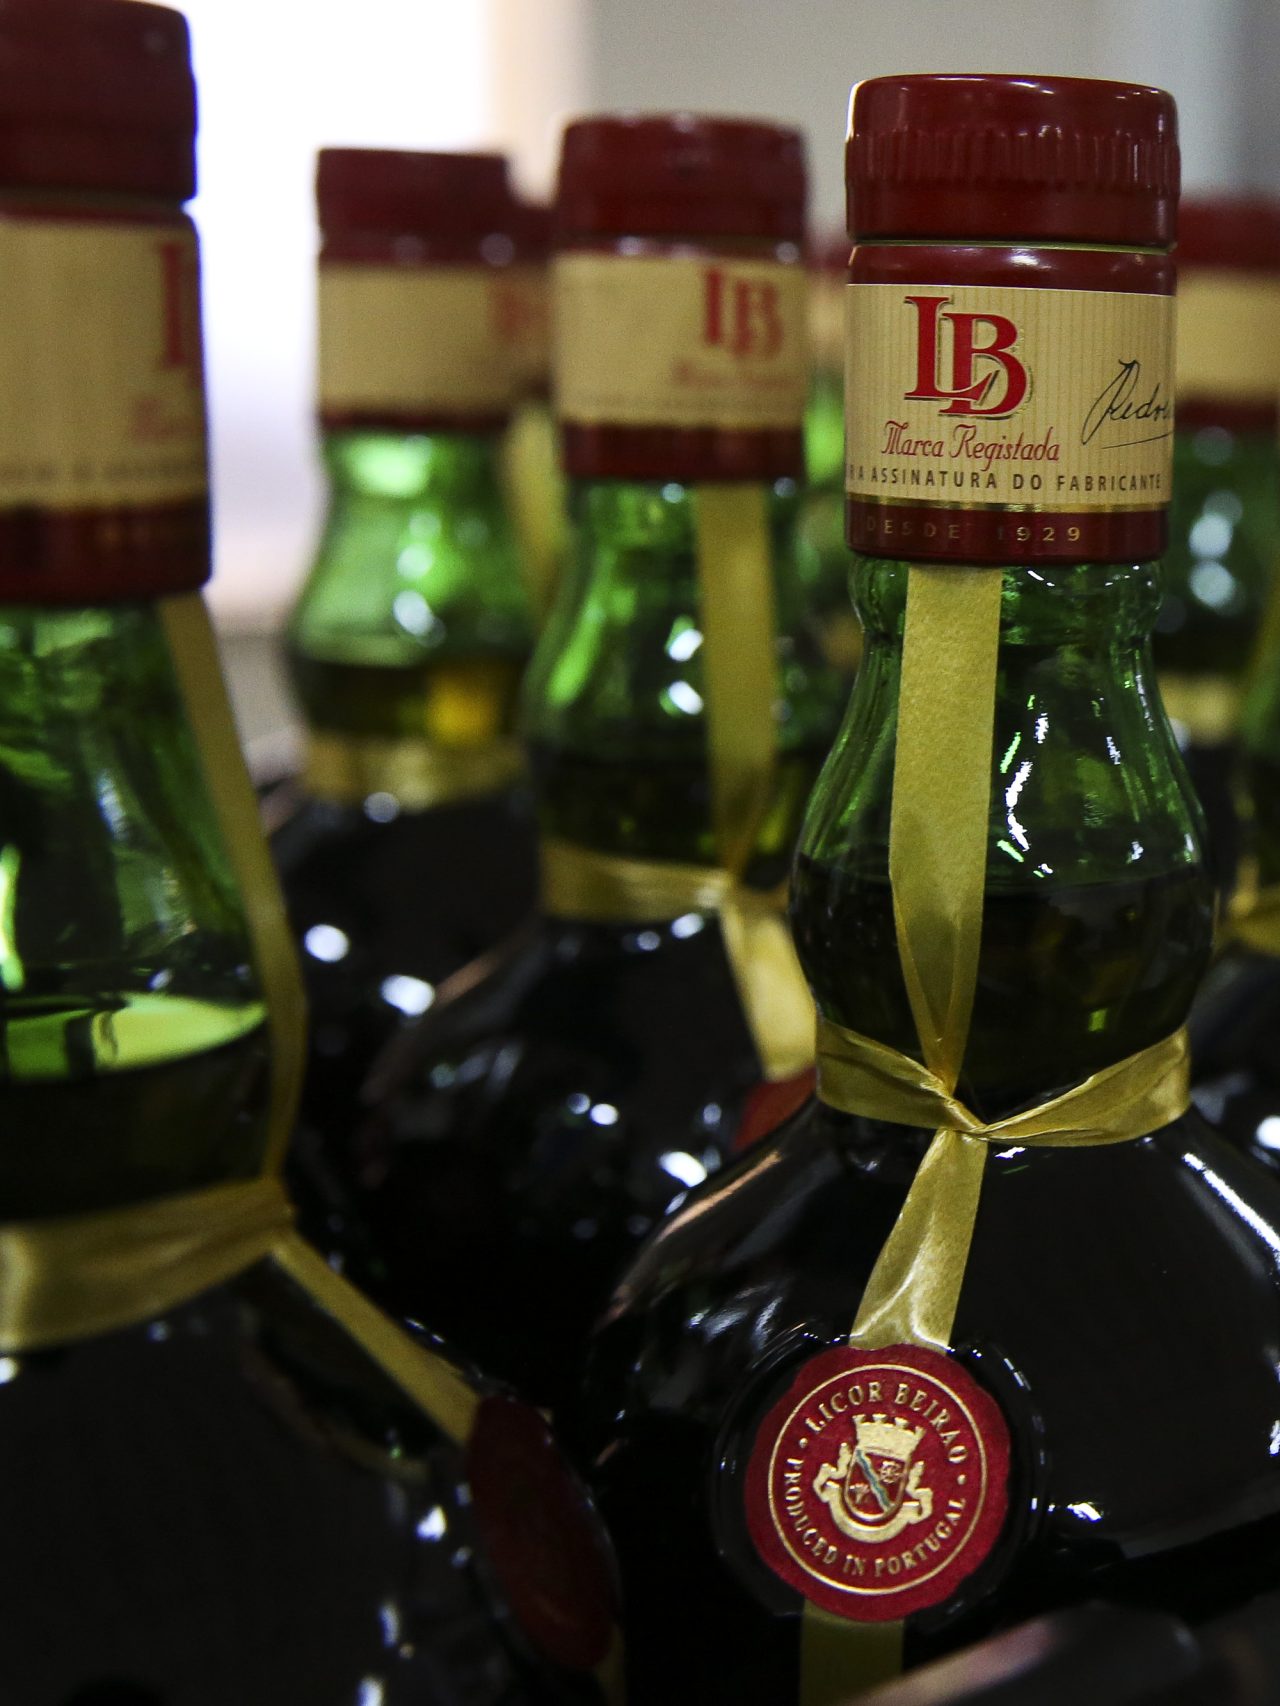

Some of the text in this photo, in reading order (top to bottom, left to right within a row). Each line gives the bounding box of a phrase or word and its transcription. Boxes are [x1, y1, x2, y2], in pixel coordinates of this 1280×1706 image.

[904, 295, 1030, 417] LB
[881, 420, 1060, 471] Marca Registada
[871, 466, 998, 489] ASSINATURA
[1012, 473, 1042, 491] DO
[1056, 473, 1161, 491] FABRICANTE
[866, 515, 1081, 543] DESDE 1929
[805, 1381, 883, 1433] LICOR
[843, 1554, 866, 1577] IN
[874, 1498, 966, 1578] PORTUGAL
